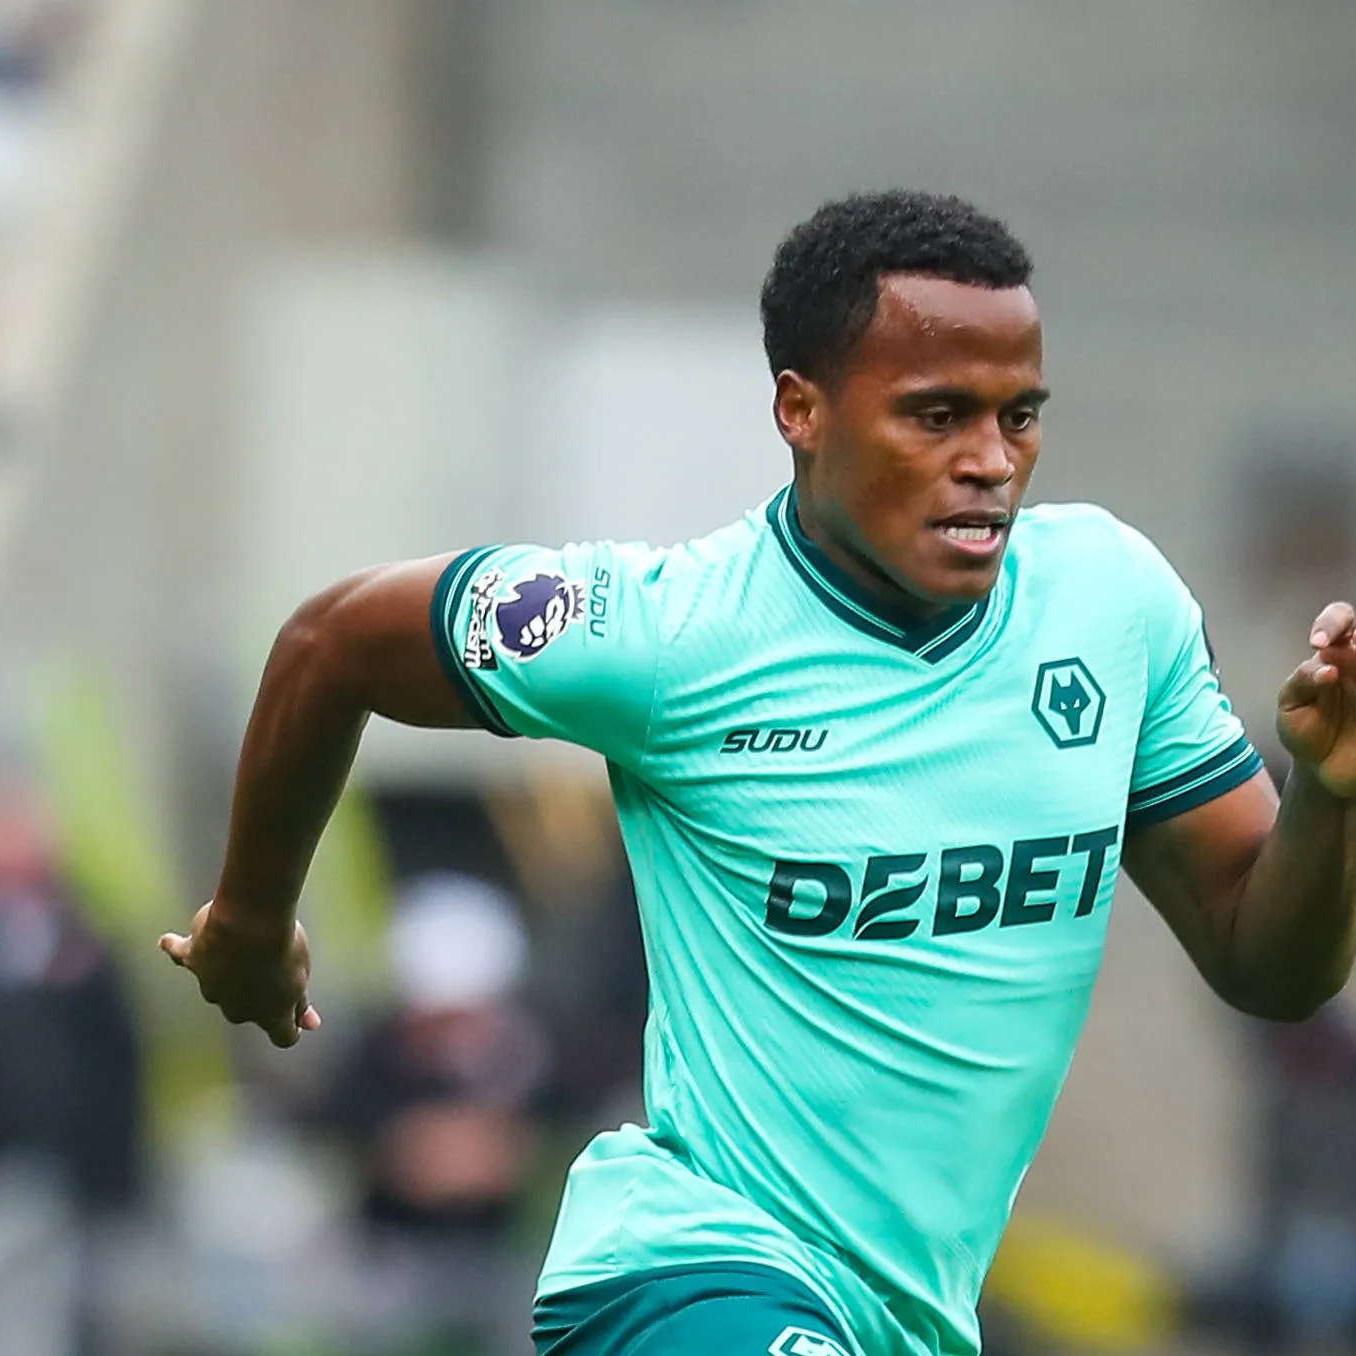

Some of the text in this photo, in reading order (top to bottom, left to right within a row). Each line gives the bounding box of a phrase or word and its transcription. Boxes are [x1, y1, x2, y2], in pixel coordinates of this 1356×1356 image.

[590, 567, 610, 638] SUDU
[720, 729, 829, 754] SUDU
[763, 825, 1119, 941] DEBET
